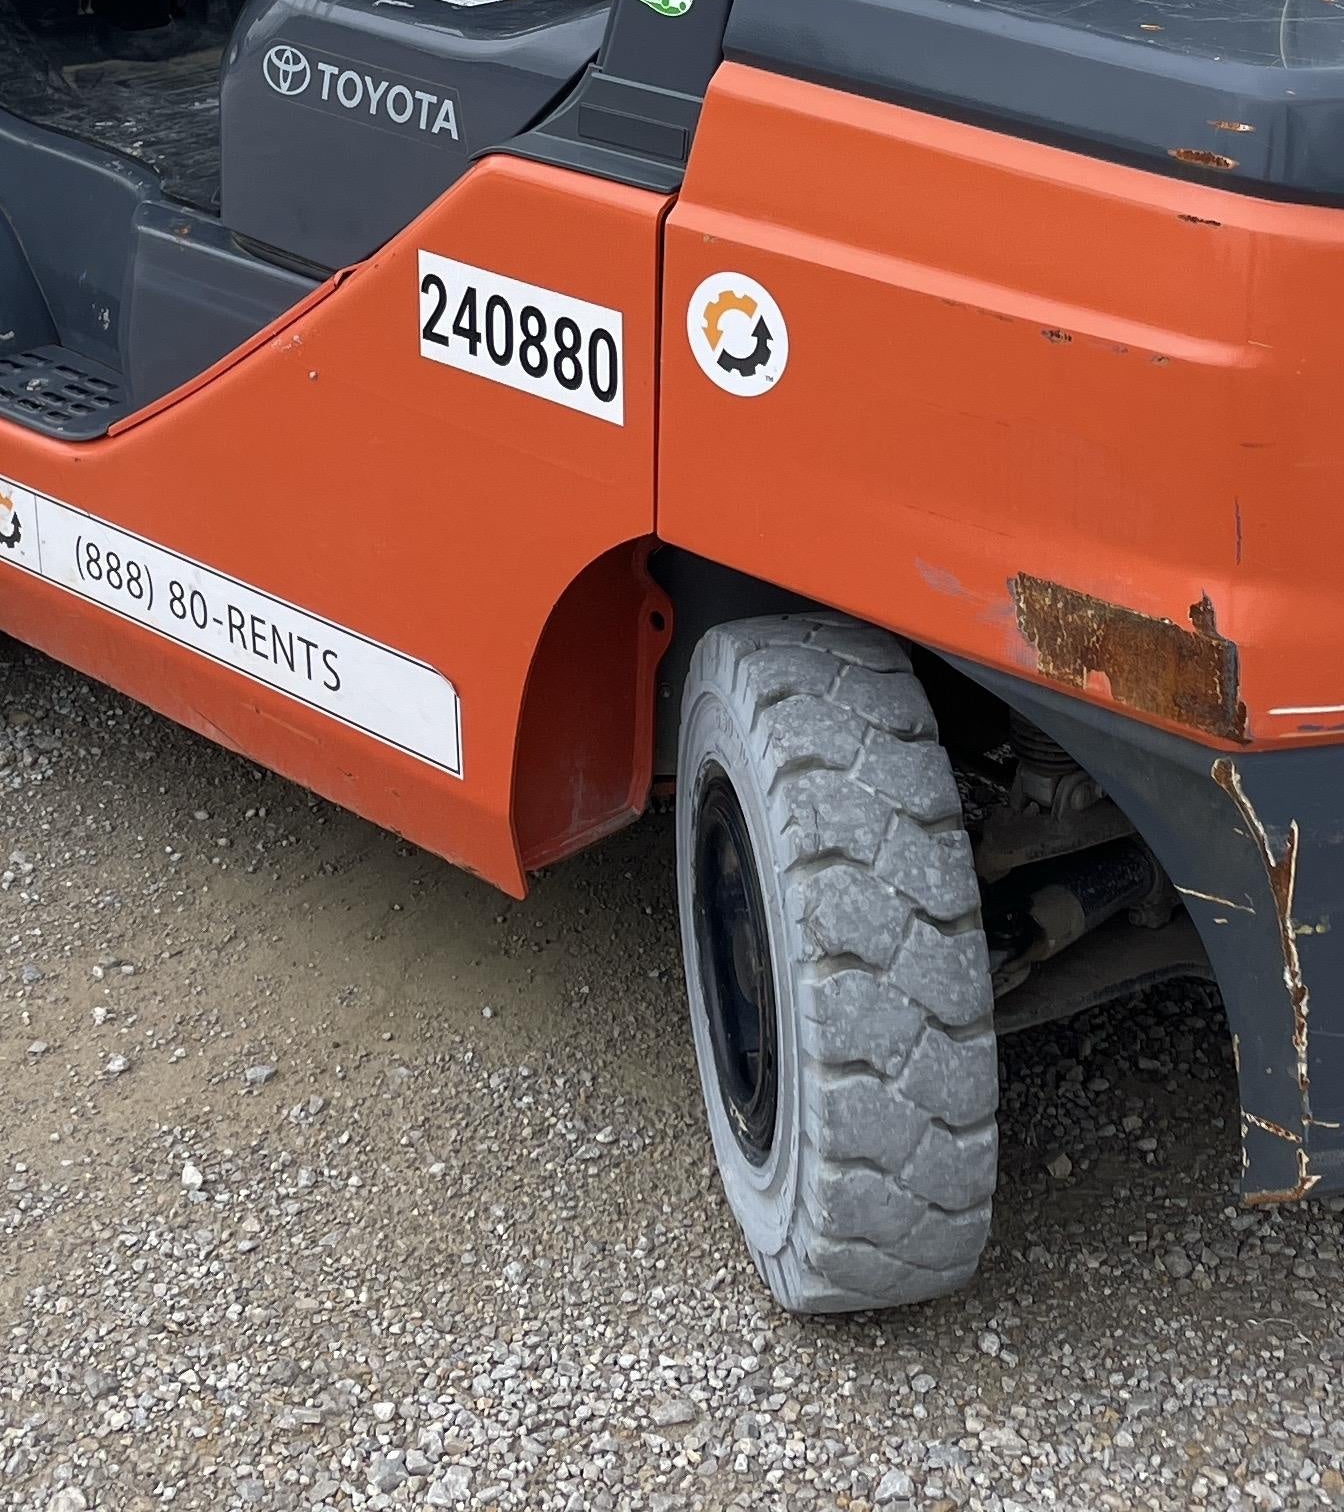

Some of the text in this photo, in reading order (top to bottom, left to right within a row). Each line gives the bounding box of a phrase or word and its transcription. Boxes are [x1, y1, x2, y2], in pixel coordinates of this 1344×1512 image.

[317, 62, 459, 141] TOYOTA
[420, 273, 618, 403] 240880
[75, 535, 341, 692] (888) 80-RENTS
